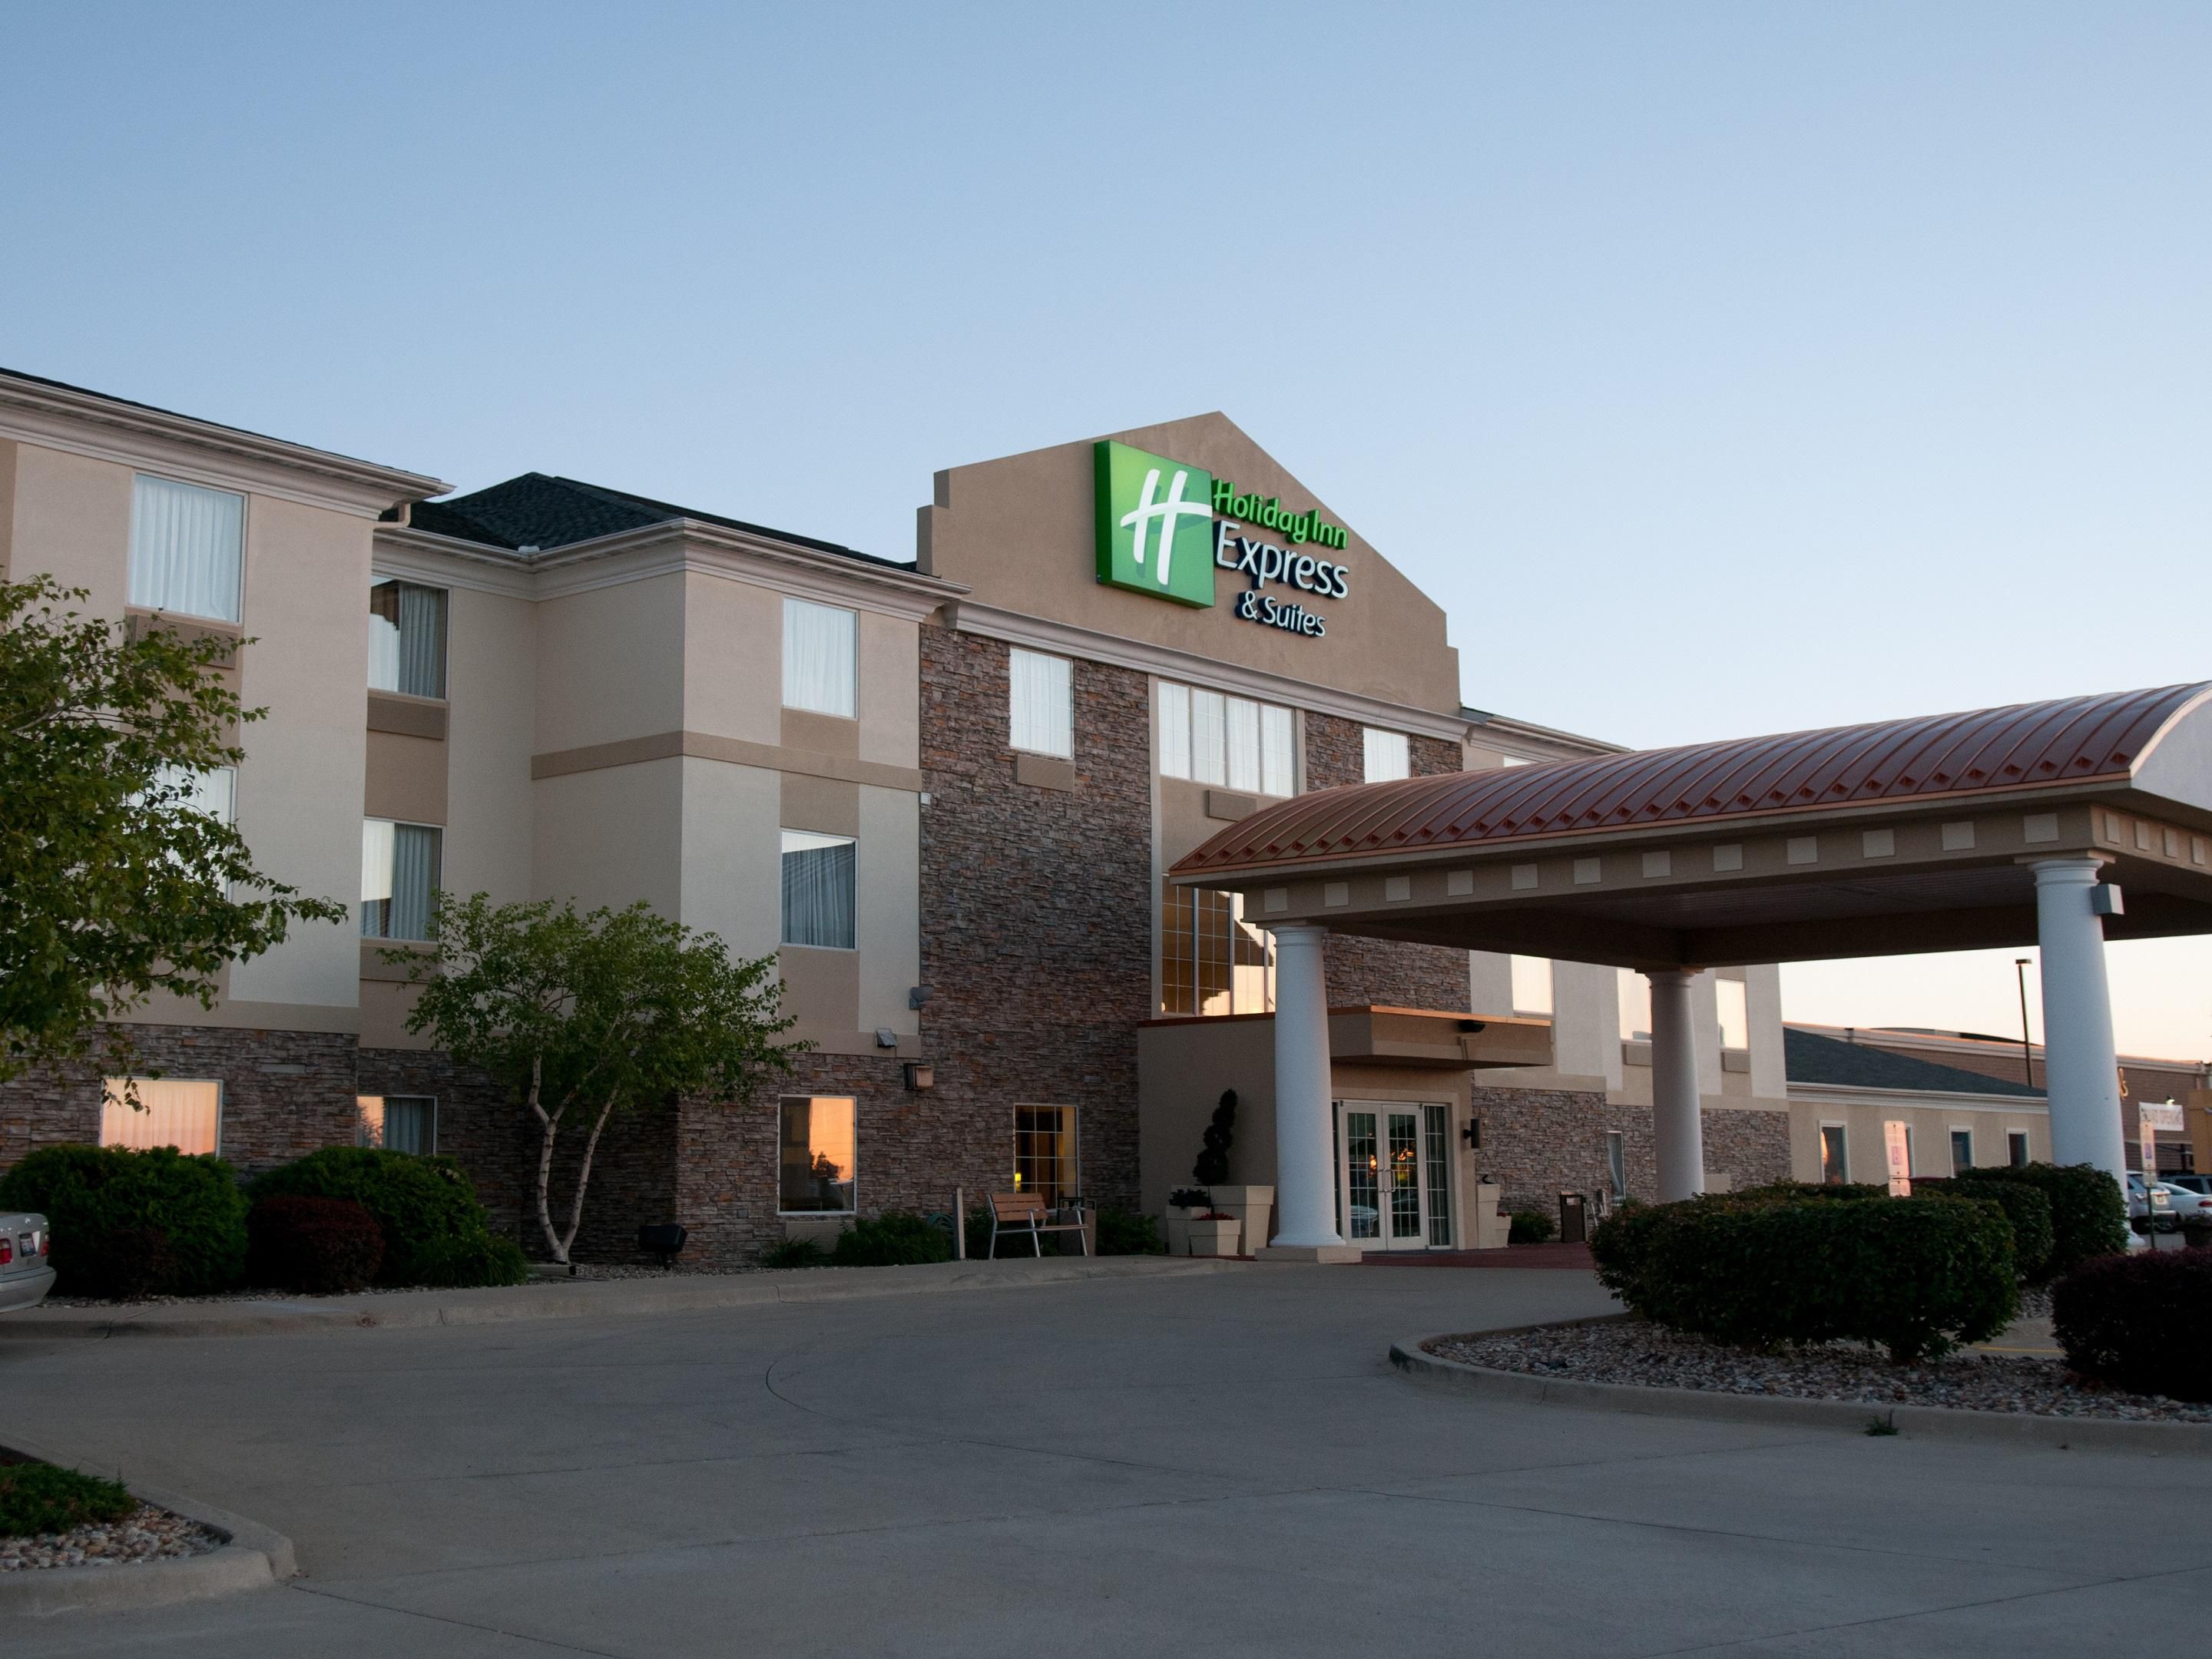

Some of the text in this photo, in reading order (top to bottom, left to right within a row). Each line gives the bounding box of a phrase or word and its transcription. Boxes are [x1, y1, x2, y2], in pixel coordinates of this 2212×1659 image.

[1213, 478, 1349, 550] Holiday Inn
[1216, 518, 1350, 600] Express
[1240, 589, 1327, 637] & Suites
